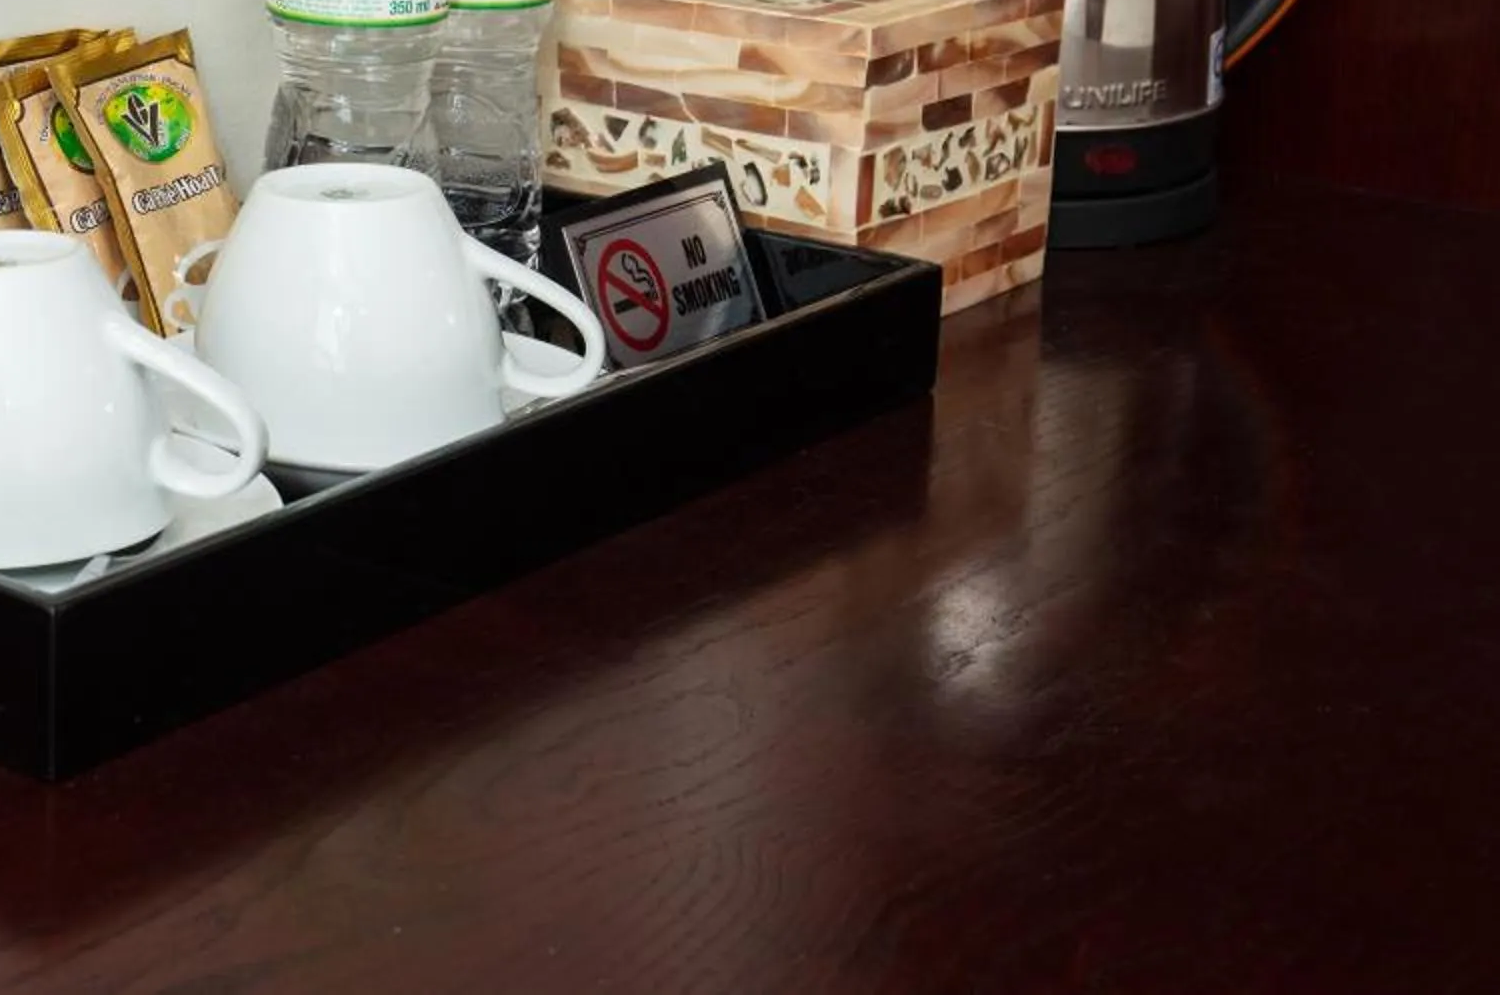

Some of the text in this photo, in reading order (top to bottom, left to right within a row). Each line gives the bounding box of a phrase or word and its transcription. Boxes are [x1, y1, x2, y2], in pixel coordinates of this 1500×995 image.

[389, 0, 413, 15] 350
[1063, 78, 1169, 110] UNILIFE
[681, 234, 707, 270] NO
[671, 266, 741, 316] SMOKING
